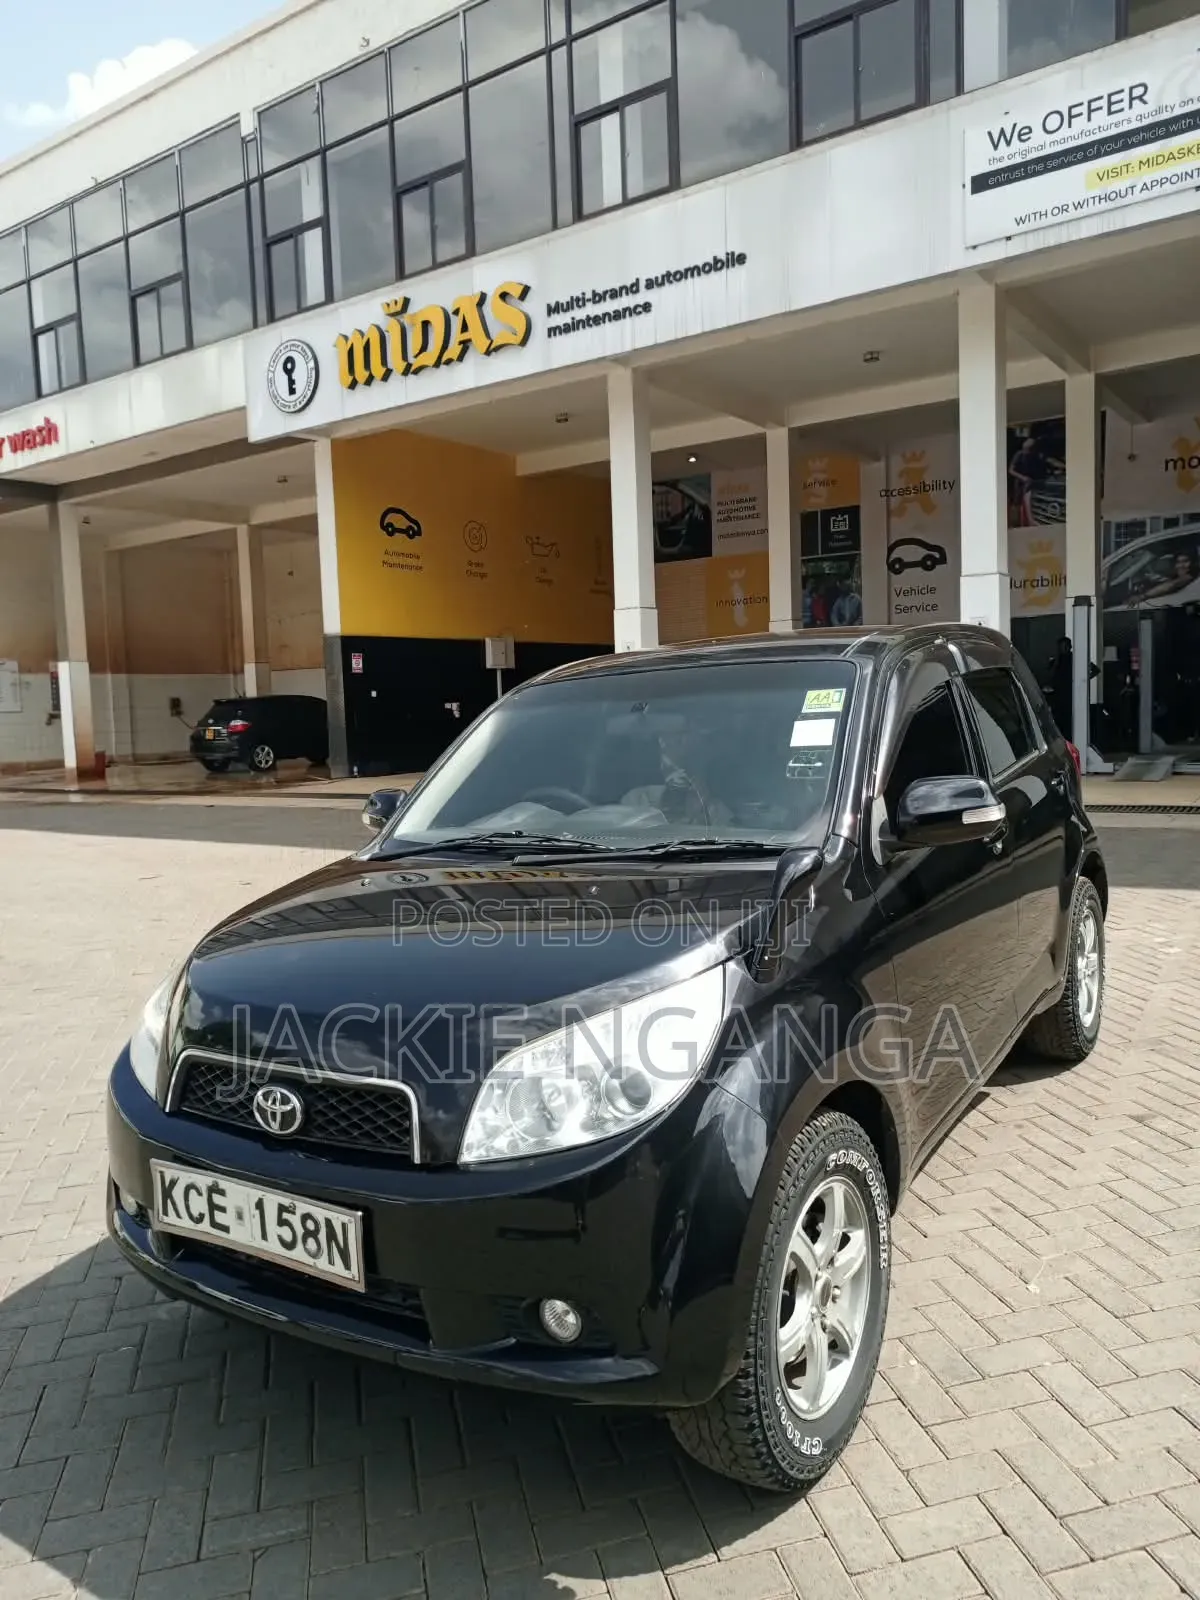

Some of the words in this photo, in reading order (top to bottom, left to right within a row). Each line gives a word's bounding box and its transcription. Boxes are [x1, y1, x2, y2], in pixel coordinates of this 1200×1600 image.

[987, 122, 1033, 151] We
[1042, 82, 1149, 135] OFFER
[988, 155, 1005, 167] the
[1007, 141, 1046, 160] original
[1049, 117, 1132, 148] manufacturers
[1135, 103, 1176, 124] quality
[988, 168, 1025, 185] entrust
[1027, 163, 1045, 175] the
[1046, 151, 1084, 169] service
[1086, 144, 1098, 157] of
[1099, 139, 1124, 155] your
[1127, 126, 1166, 145] vehicle
[1168, 118, 1194, 133] with
[1096, 162, 1135, 181] VISIT:
[1014, 208, 1048, 227] WITH
[1051, 203, 1070, 217] OR
[1072, 185, 1137, 212] WITHOUT
[1140, 167, 1200, 193] APPOINT
[546, 278, 641, 318] Multi-brand
[644, 251, 748, 291] automobile
[547, 301, 653, 338] maintenance
[7, 416, 59, 454] wash
[879, 479, 956, 498] accessibility
[894, 585, 937, 598] Vehicle
[1010, 574, 1066, 590] urabilit
[715, 595, 768, 608] innovation
[894, 601, 939, 615] Service
[158, 1170, 231, 1235] KCE
[254, 1196, 352, 1272] 158N
